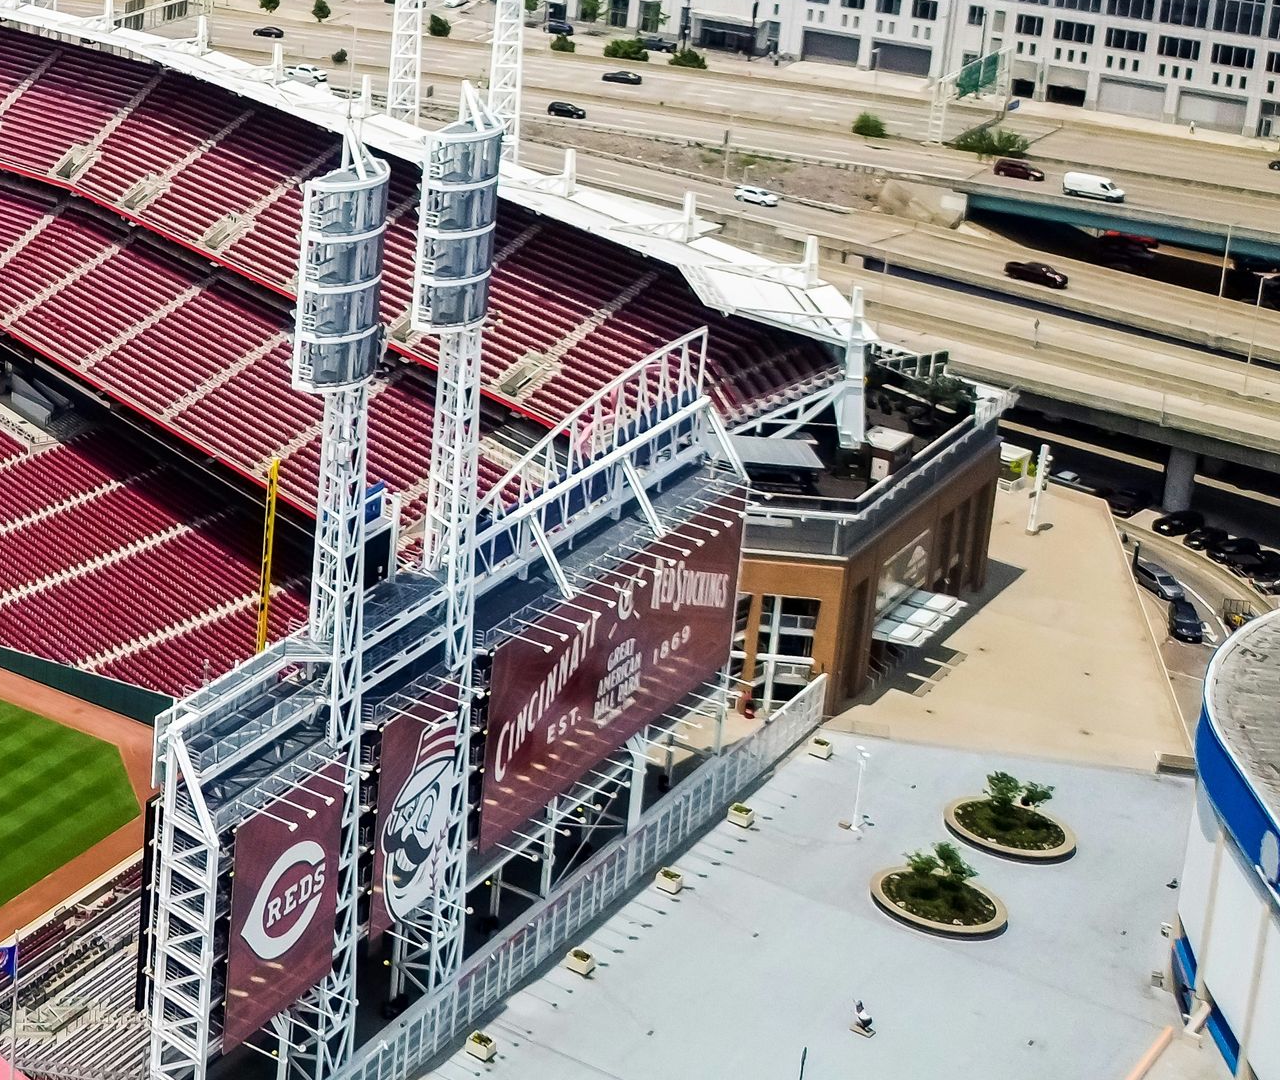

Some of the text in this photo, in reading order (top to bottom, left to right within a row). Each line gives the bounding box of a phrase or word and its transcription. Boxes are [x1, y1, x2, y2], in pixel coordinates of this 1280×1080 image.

[608, 638, 637, 671] GREAT
[653, 625, 690, 665] 1869
[597, 652, 642, 699] AMERICAN
[495, 614, 597, 782] CINCINNATI
[546, 706, 582, 744] EST.
[266, 862, 326, 928] REDS
